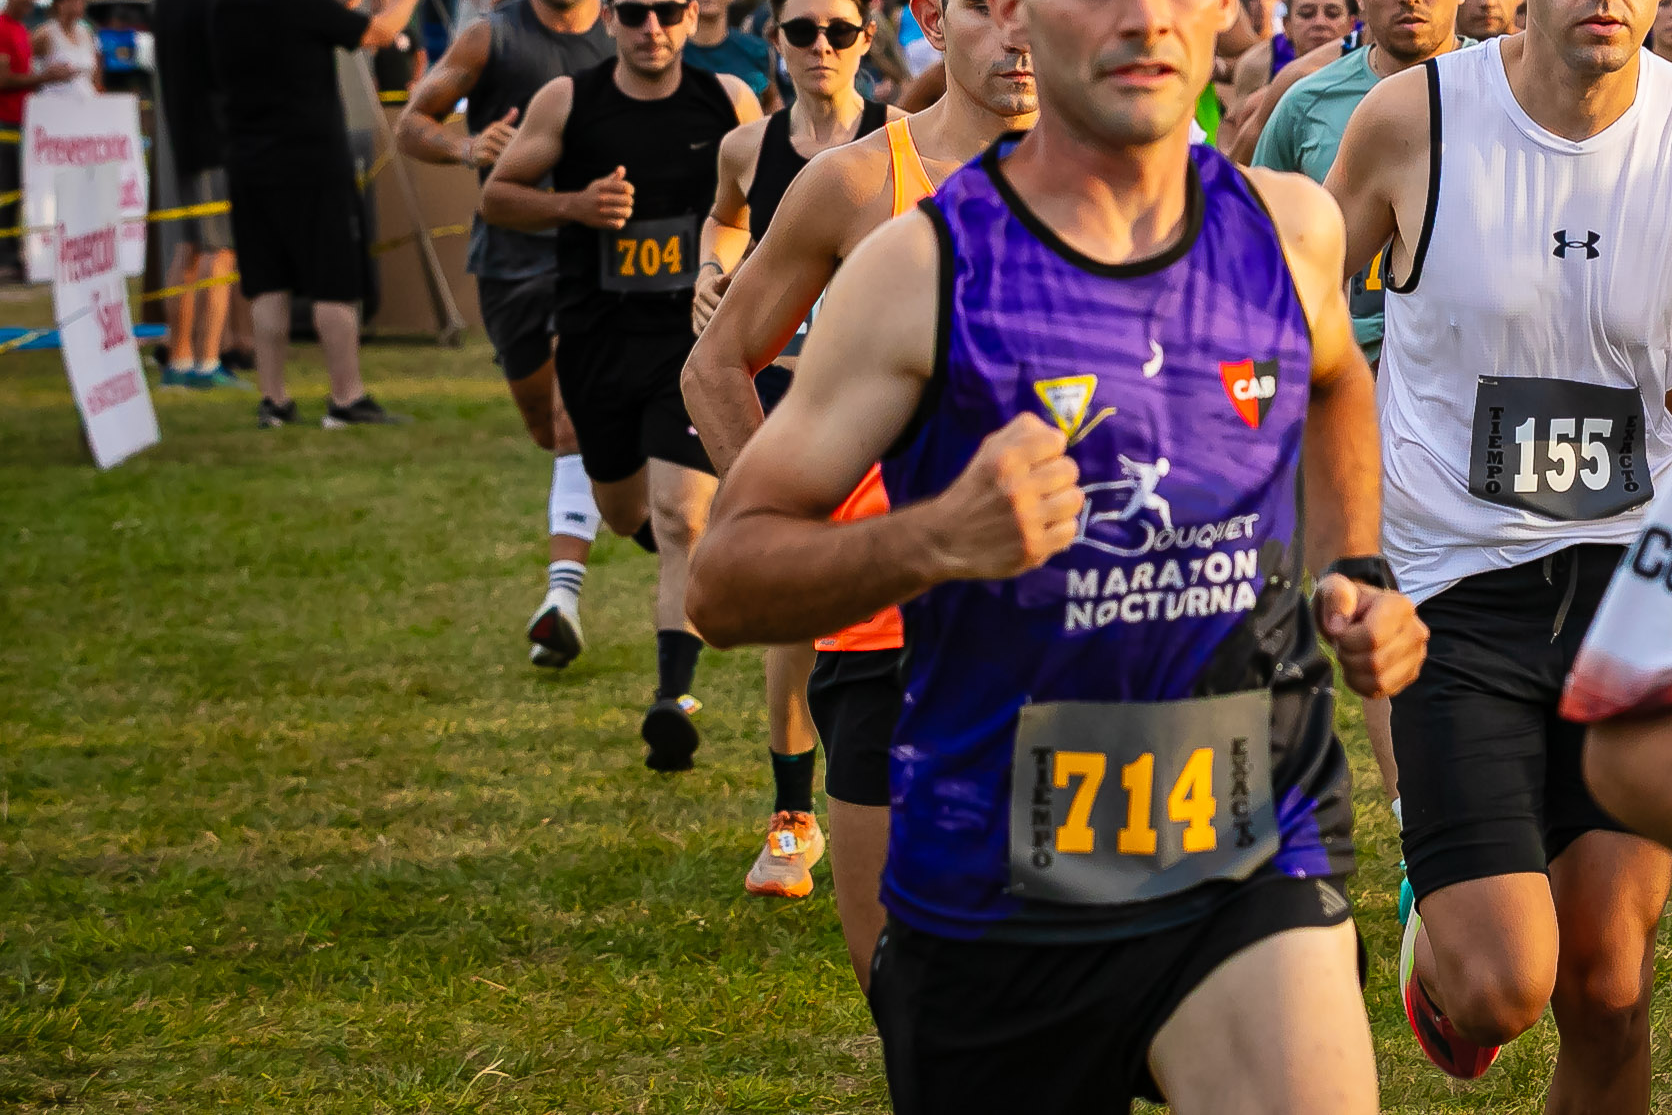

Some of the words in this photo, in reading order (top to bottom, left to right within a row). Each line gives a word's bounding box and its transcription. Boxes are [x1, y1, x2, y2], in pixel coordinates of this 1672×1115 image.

[616, 235, 682, 276] 704
[1483, 406, 1505, 495] TIEMPO
[1513, 417, 1613, 493] 155
[1064, 581, 1257, 631] NOCTURNA
[1065, 549, 1259, 599] MARATON
[1031, 746, 1053, 869] TIEMPO
[1053, 748, 1217, 855] 714
